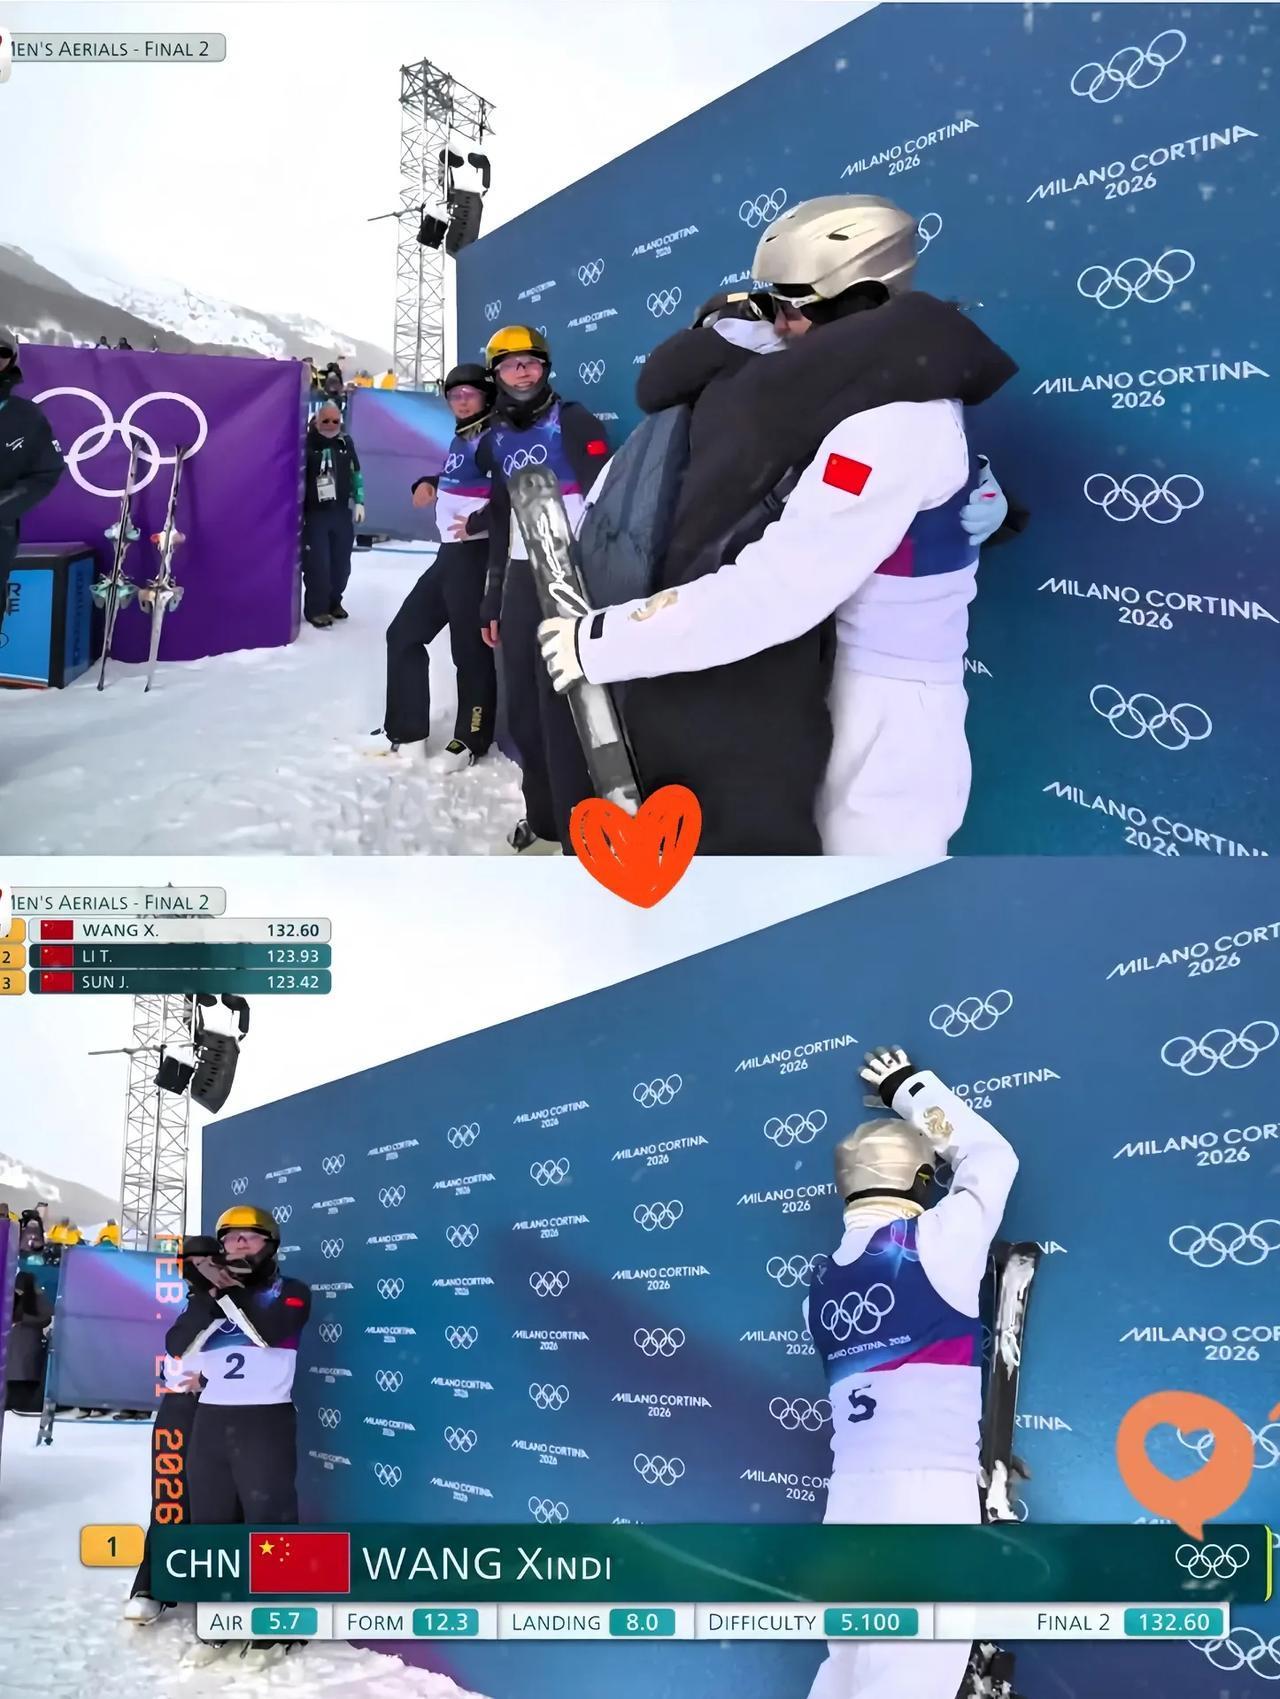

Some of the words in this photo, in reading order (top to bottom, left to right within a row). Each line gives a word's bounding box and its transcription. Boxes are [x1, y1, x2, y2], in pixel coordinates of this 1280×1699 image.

[840, 144, 901, 179] MILANO
[904, 118, 980, 154] CORTINA
[888, 153, 921, 176] 2026
[1027, 161, 1125, 203] MILANO
[1130, 124, 1259, 172] CORTINA
[1104, 173, 1157, 200] 2026
[1032, 372, 1133, 395] MILANO
[1138, 360, 1270, 387] CORTINA
[1111, 390, 1165, 409] 2026
[1038, 577, 1140, 604] MILANO
[1146, 589, 1280, 625] CORTINA
[1118, 606, 1173, 630] 2026
[1042, 781, 1147, 827] MILANO
[1152, 816, 1269, 857] CORTIN
[1125, 826, 1181, 857] 2026
[1106, 942, 1209, 980] MILANO
[1214, 922, 1280, 952] CORT
[1188, 952, 1241, 977] 2026
[735, 1049, 791, 1072] MILANO
[794, 1034, 859, 1058] CORTINA
[780, 1059, 808, 1075] 2026
[973, 1068, 1061, 1094] CORTINA
[513, 1108, 549, 1124] MILANO
[550, 1100, 589, 1117] CORTINA
[611, 1144, 657, 1162] MILANO
[658, 1135, 709, 1152] CORTINA
[1113, 1132, 1218, 1160] MILANO
[1223, 1123, 1280, 1144] COR
[647, 1154, 669, 1166] 2026
[1196, 1146, 1250, 1166] 2026
[737, 1188, 793, 1206] MILANO
[782, 1201, 811, 1214] 2026
[512, 1219, 549, 1231] MILANO
[549, 1214, 590, 1228] CORTINA
[611, 1268, 657, 1280] MILANO
[658, 1265, 710, 1278] CORTINA
[647, 1280, 671, 1291] 2026
[511, 1329, 548, 1341] MILANO
[549, 1329, 590, 1341] CORTINA
[739, 1331, 798, 1342] MILANO
[1119, 1326, 1227, 1342] MILANO
[786, 1344, 816, 1355] 2026
[1204, 1345, 1260, 1361] 2026
[223, 1353, 245, 1379] 2
[611, 1393, 658, 1405] MILANO
[659, 1395, 712, 1408] CORTINA
[847, 1384, 877, 1423] 5
[648, 1407, 672, 1418] 2026
[511, 1440, 547, 1453] MILANO
[548, 1445, 590, 1459] CORTINA
[739, 1469, 798, 1486] MILANO
[786, 1488, 816, 1502] 2026
